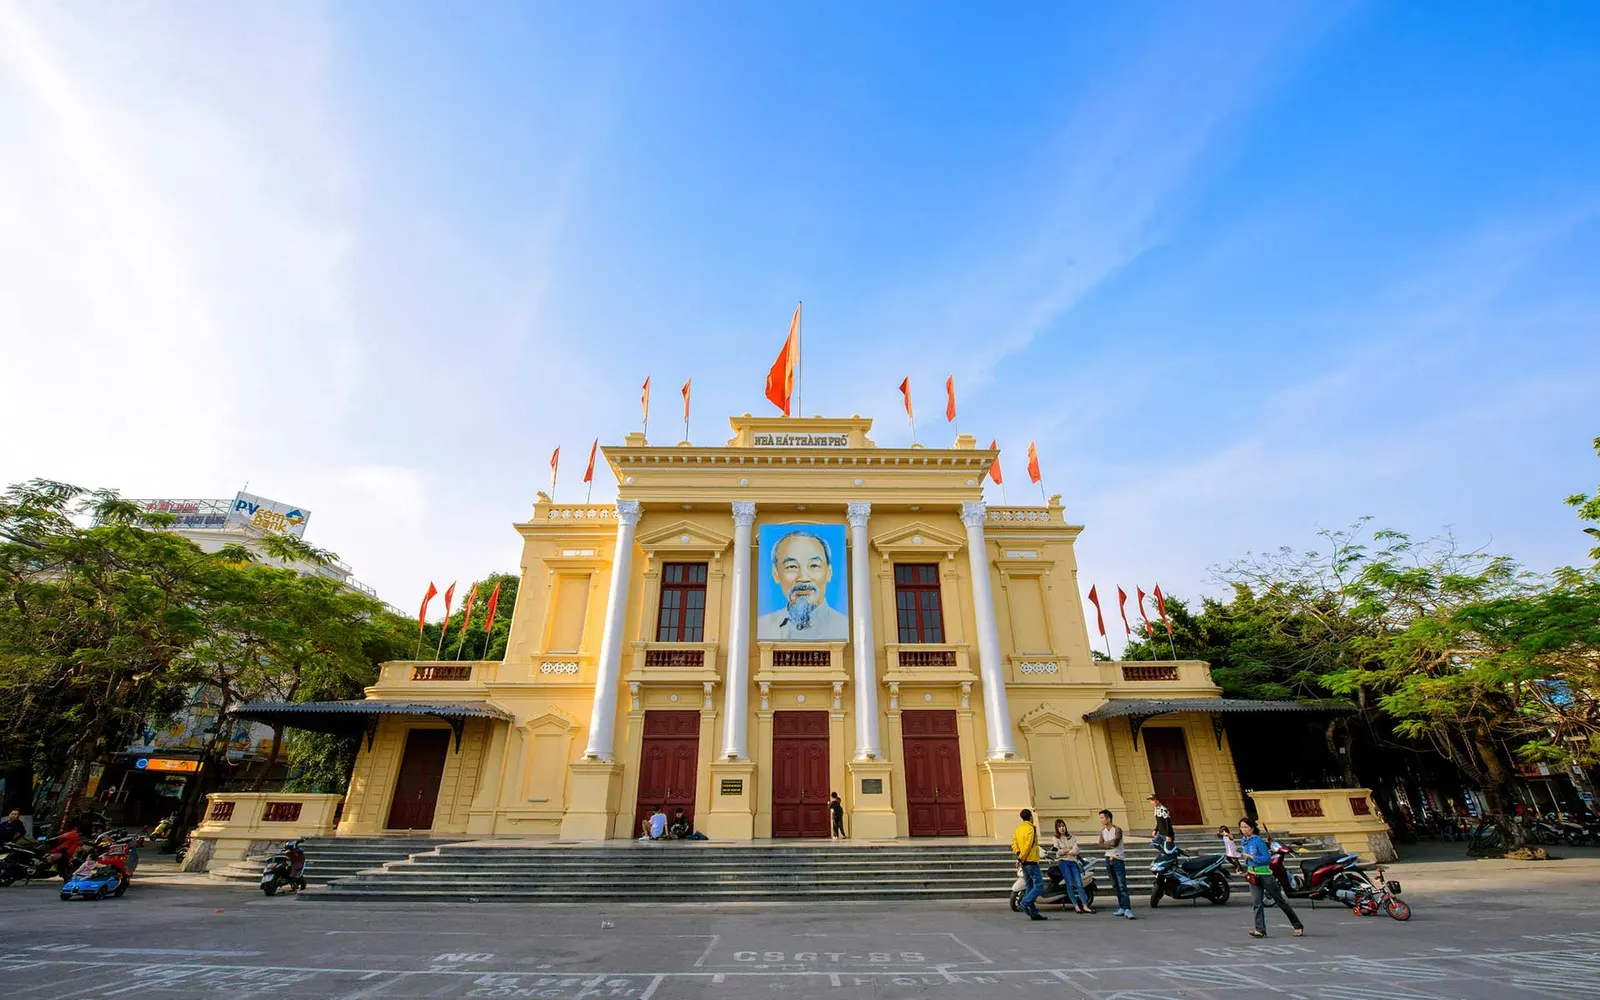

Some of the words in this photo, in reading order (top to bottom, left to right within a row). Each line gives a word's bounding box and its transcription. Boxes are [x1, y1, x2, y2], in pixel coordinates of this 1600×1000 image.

[754, 433, 774, 446] NHÀ
[775, 433, 795, 446] HÁT
[795, 433, 828, 446] THÀNH
[828, 434, 848, 447] PHỐ
